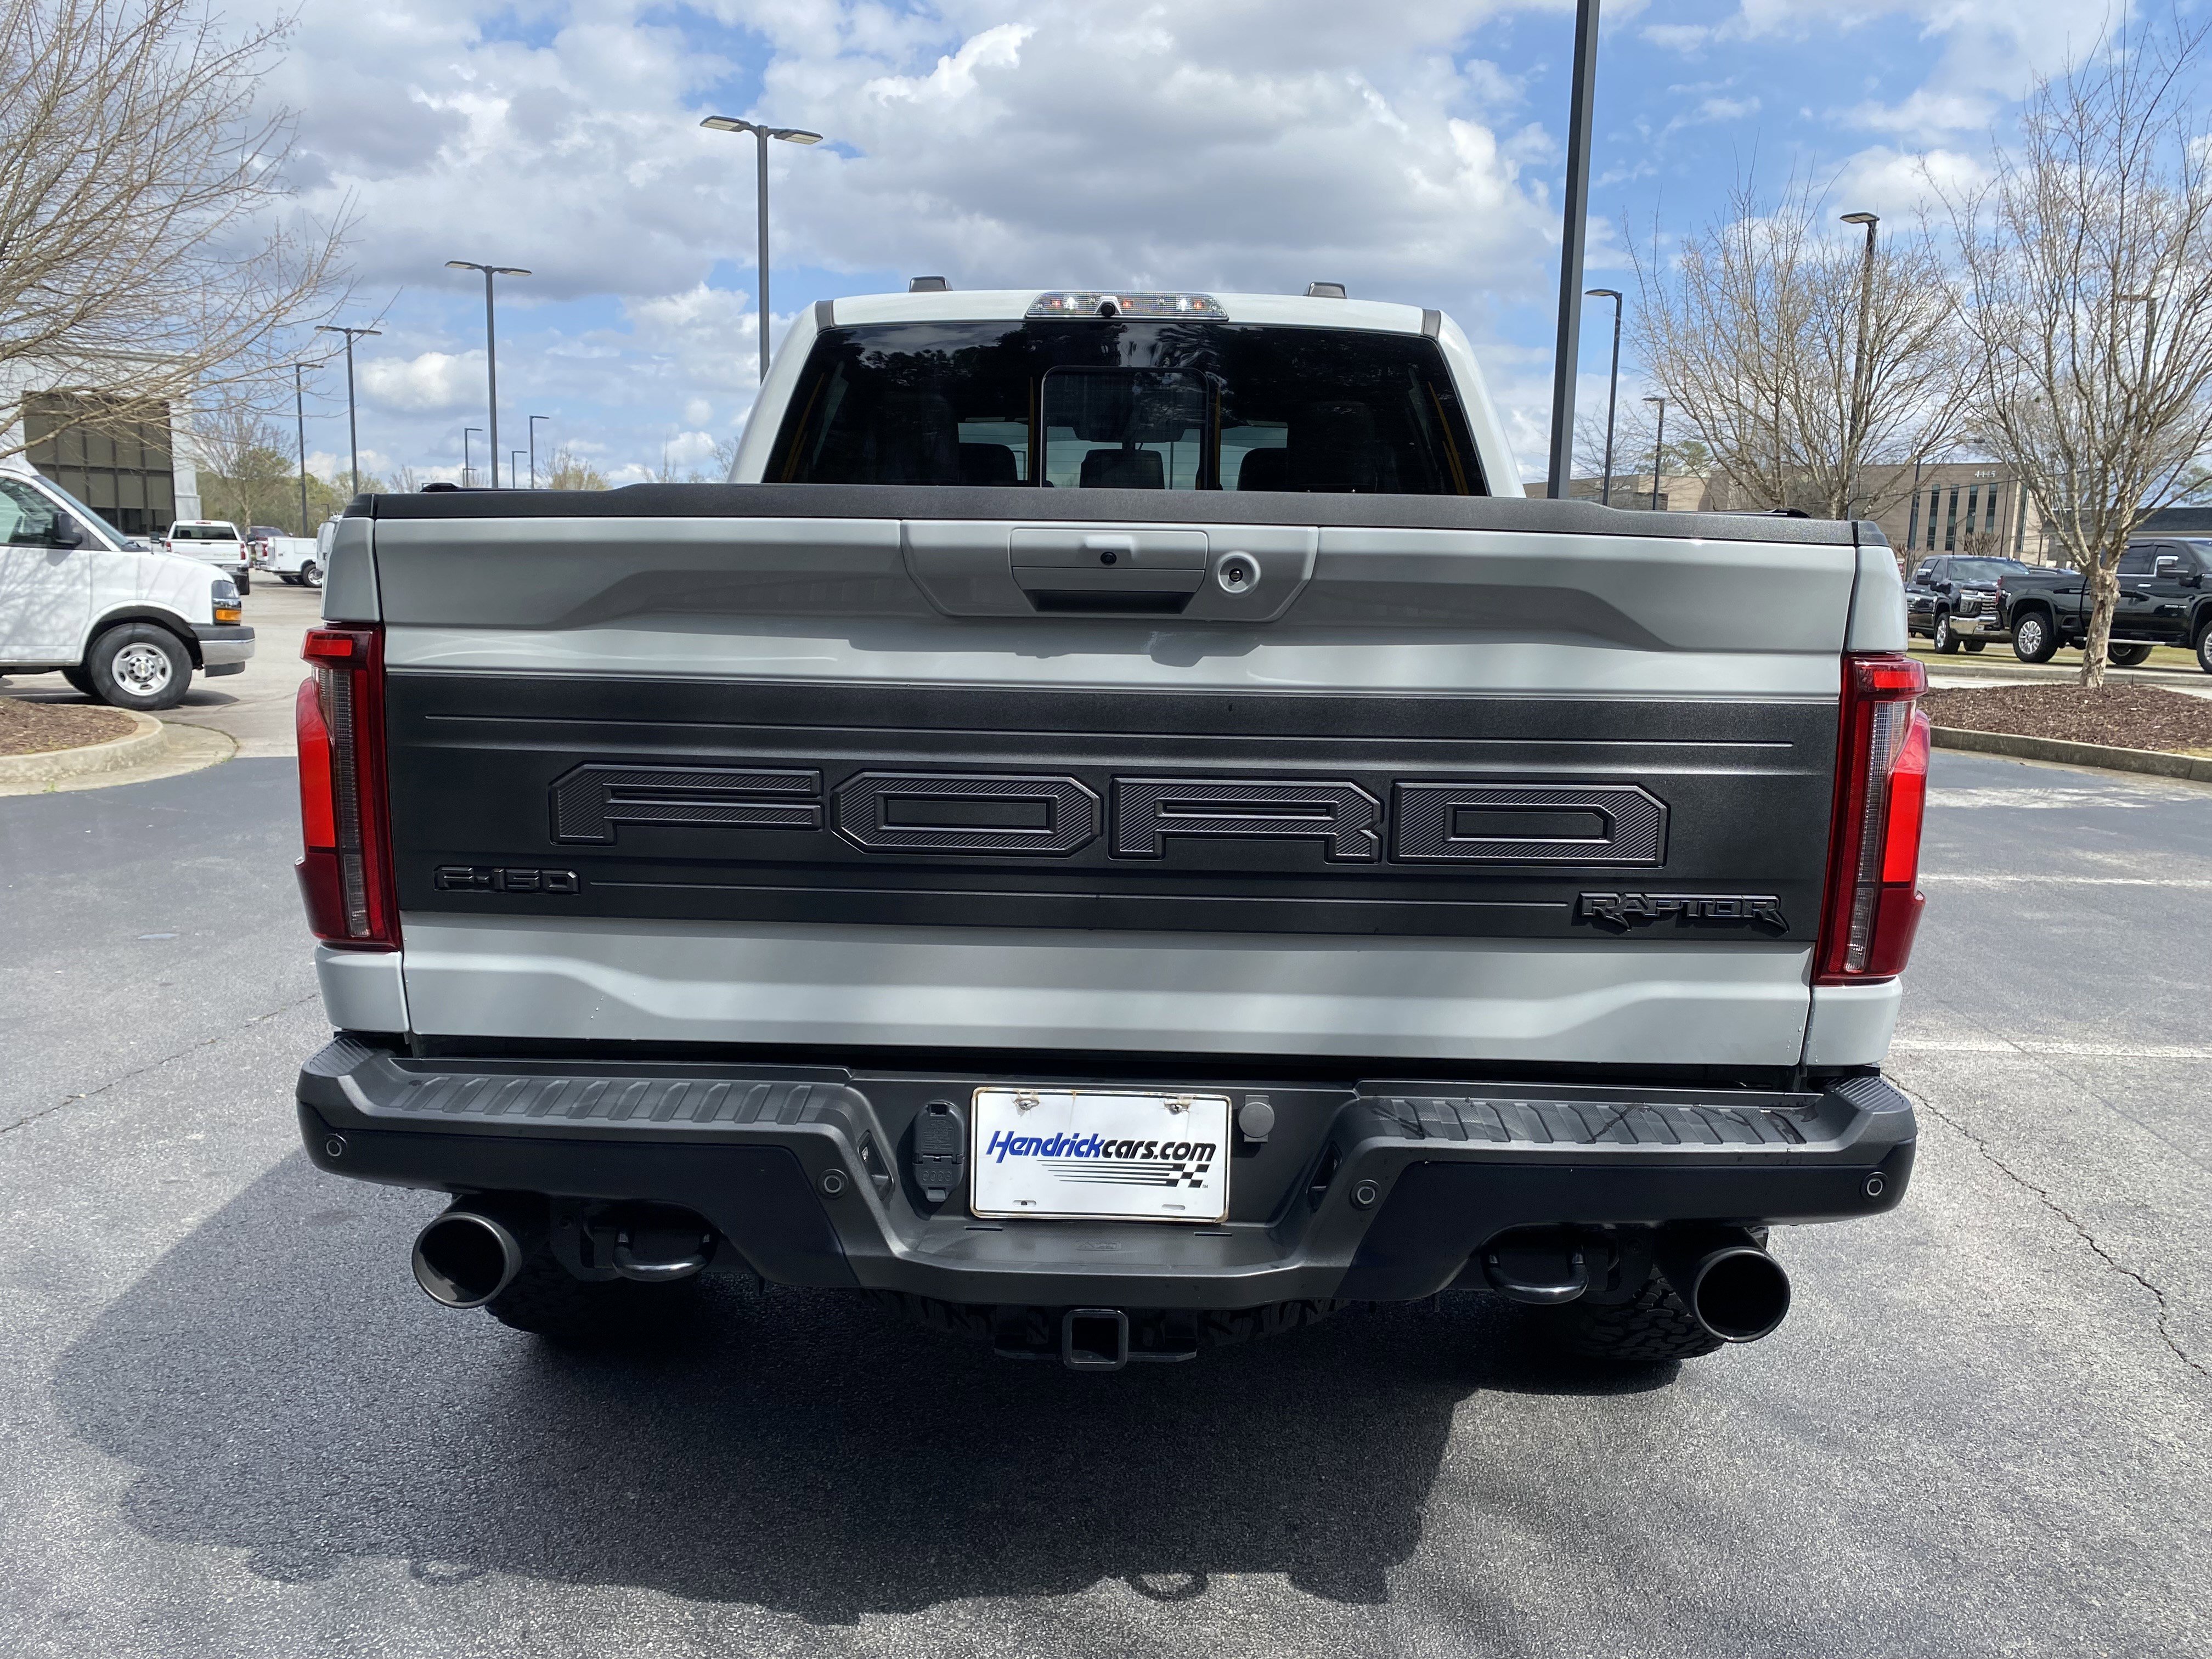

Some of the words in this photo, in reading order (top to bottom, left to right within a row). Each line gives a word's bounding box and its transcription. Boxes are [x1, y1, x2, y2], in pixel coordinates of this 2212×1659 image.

[1974, 470, 1996, 478] 4445
[550, 761, 1670, 868] FORD
[434, 865, 580, 895] F-150
[1580, 892, 1788, 933] RAPTOR
[986, 1130, 1216, 1163] Hendrickcars.com
